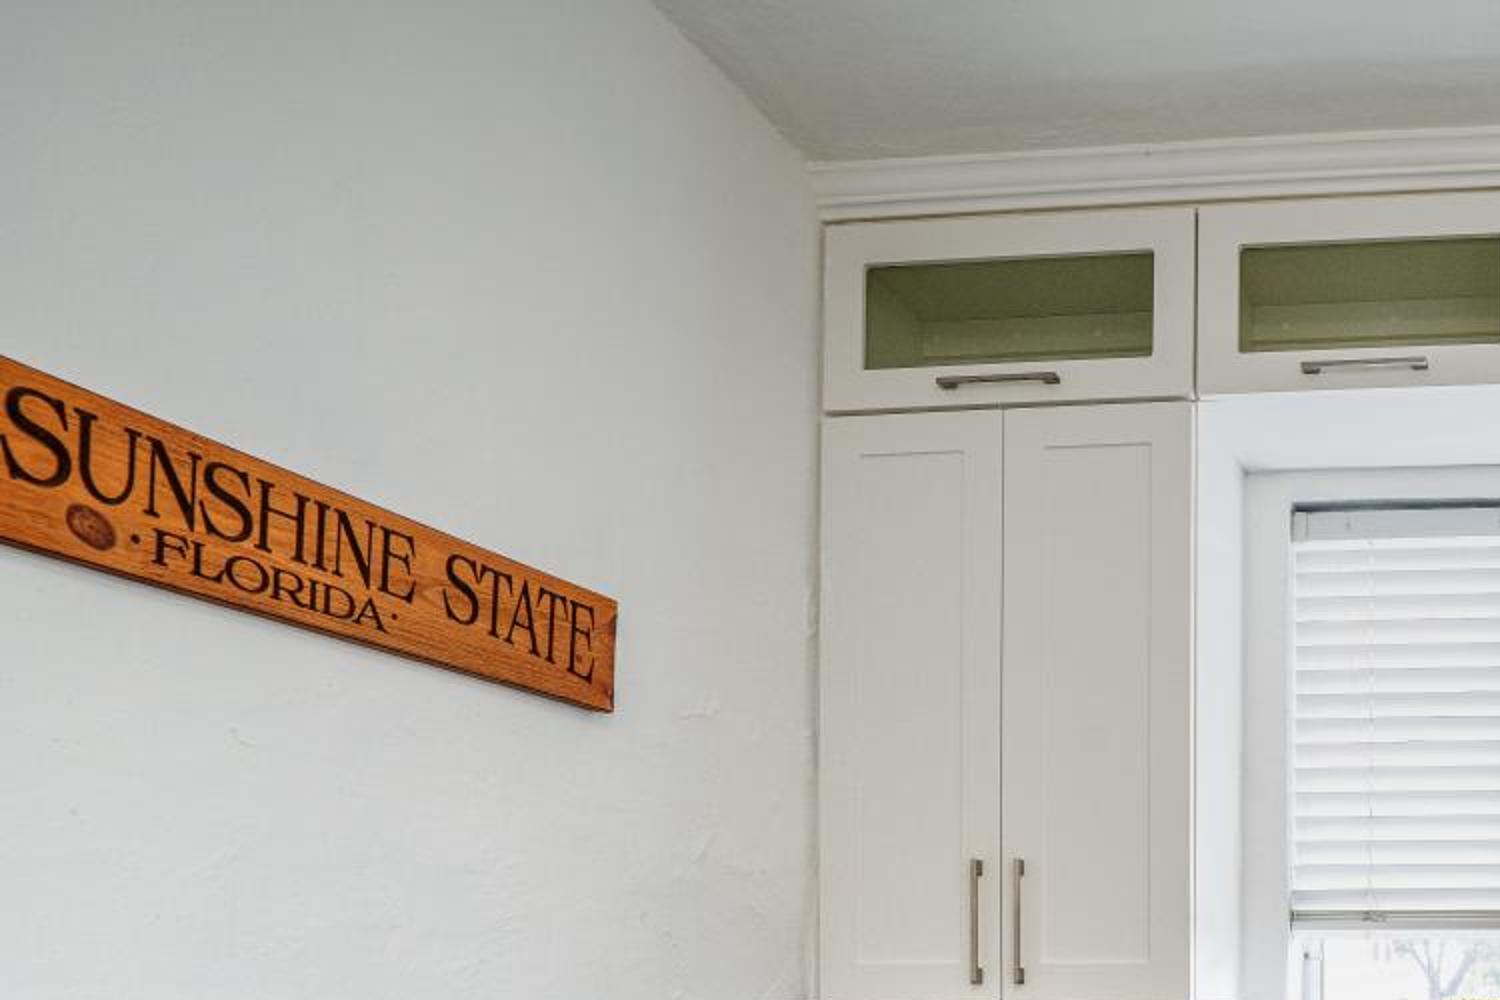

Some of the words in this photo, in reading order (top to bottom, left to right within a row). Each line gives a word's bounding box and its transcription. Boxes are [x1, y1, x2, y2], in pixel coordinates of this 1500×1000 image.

[1, 386, 416, 603] SUNSHINE
[442, 554, 595, 684] STATE
[151, 528, 389, 635] FLORIDA
